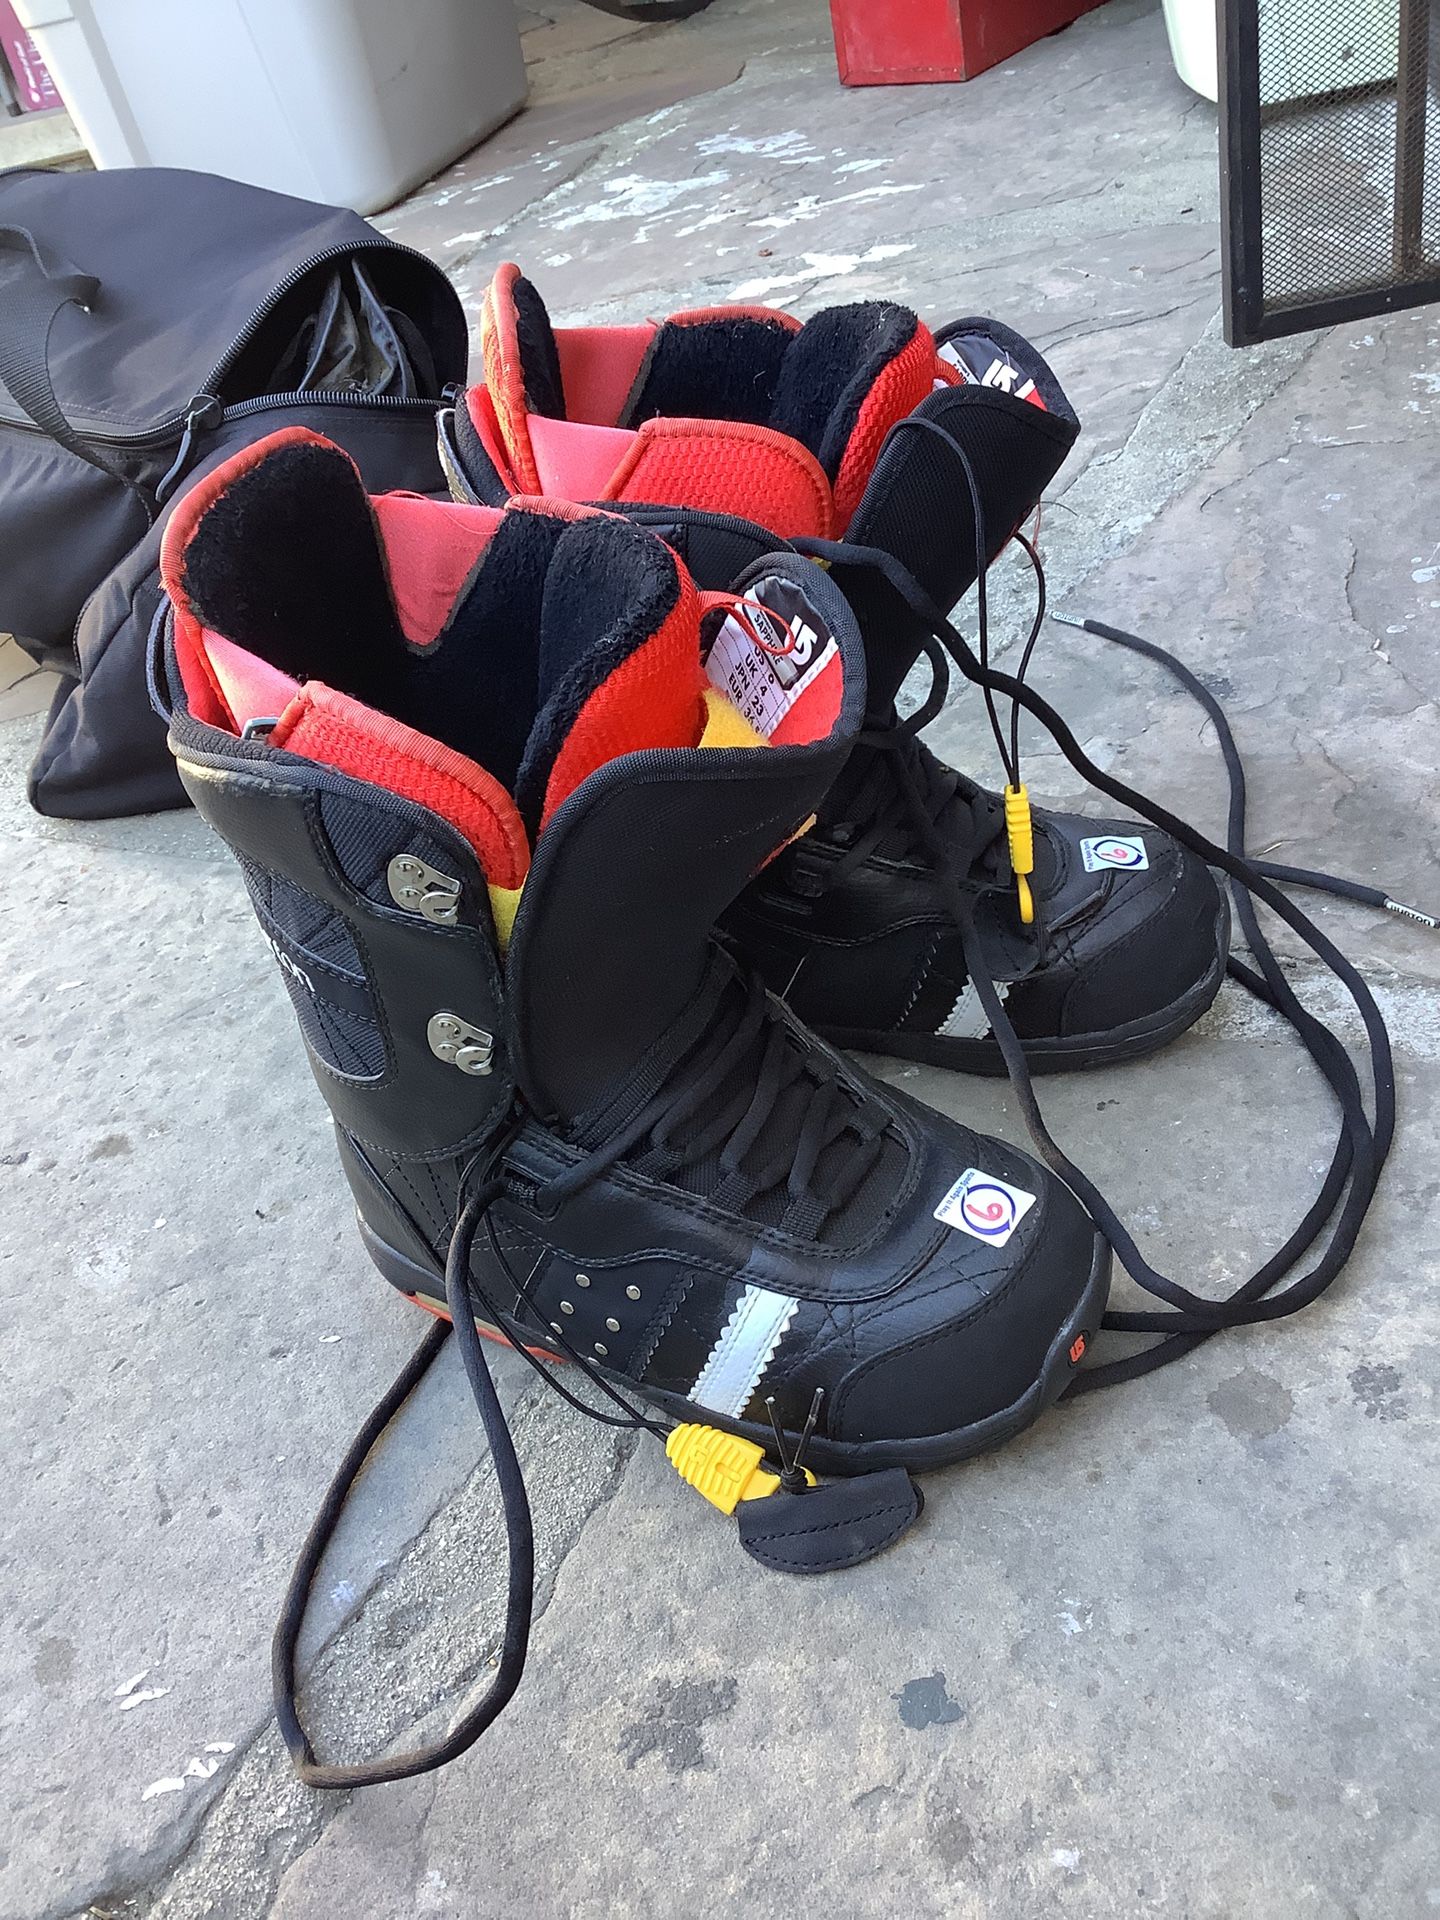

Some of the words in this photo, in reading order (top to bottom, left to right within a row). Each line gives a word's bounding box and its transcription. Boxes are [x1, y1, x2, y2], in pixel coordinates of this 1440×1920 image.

[753, 613, 784, 666] SAPPHRE
[728, 673, 744, 704] EUR
[734, 663, 751, 692] JPN
[751, 695, 764, 717] 23
[745, 653, 760, 679] UK
[760, 685, 768, 698] 4
[937, 1204, 951, 1217] Play
[950, 1184, 965, 1201] Again
